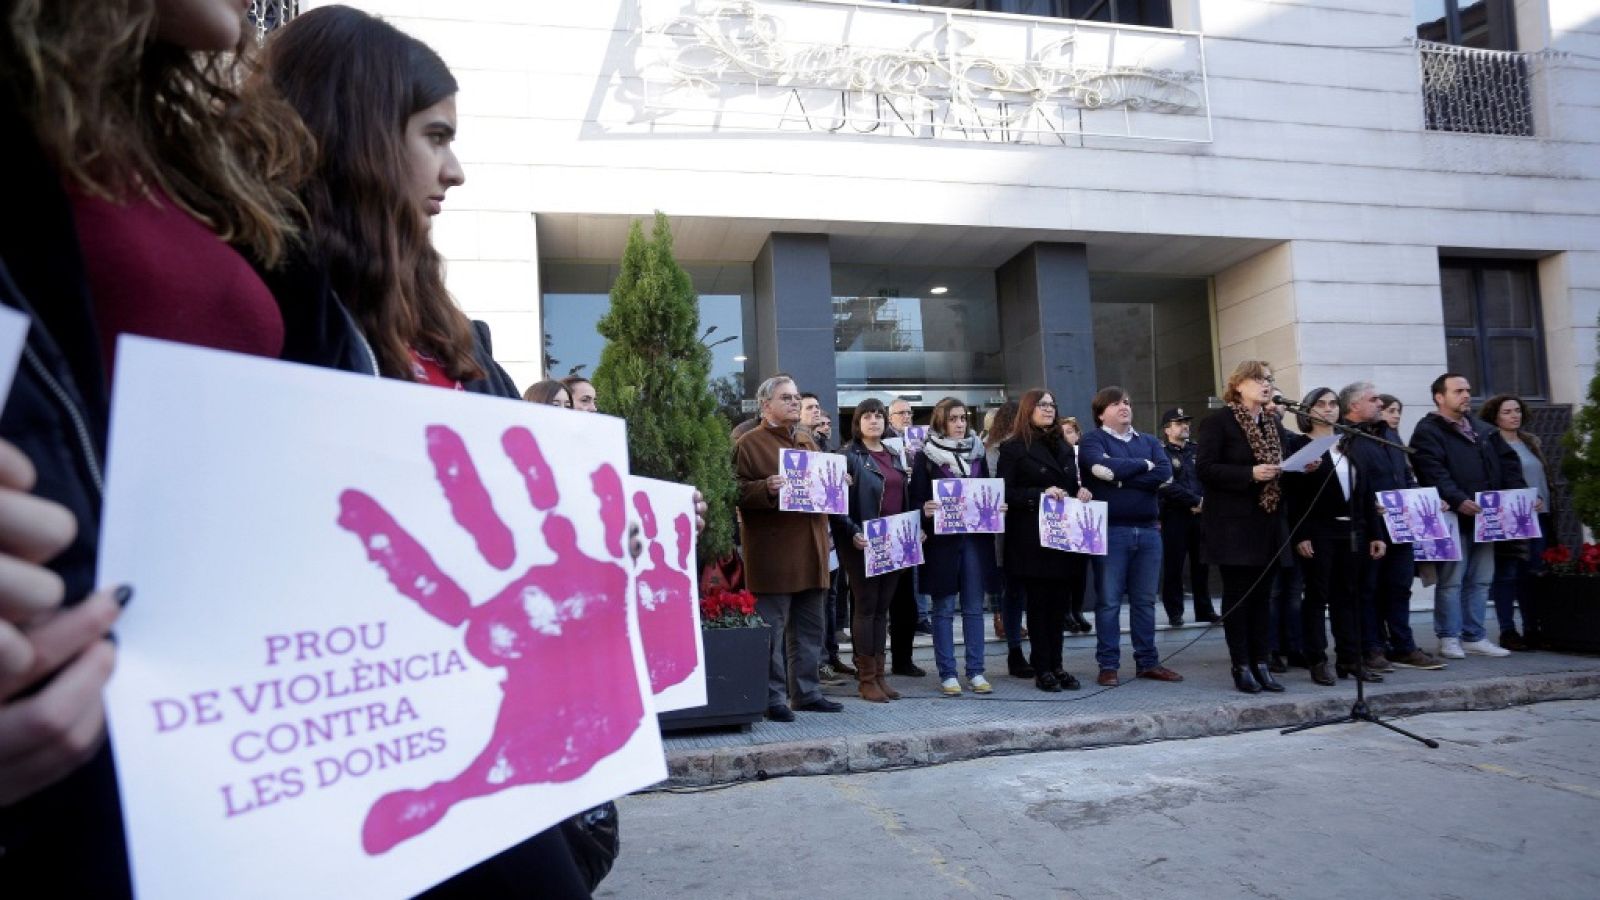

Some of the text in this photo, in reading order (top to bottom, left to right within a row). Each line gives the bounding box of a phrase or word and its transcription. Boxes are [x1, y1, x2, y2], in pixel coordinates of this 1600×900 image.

[264, 621, 388, 667] PROU
[150, 649, 469, 734] DE VIOLÈNCIA
[230, 696, 420, 763] CONTRA
[220, 726, 448, 818] LES DONES
